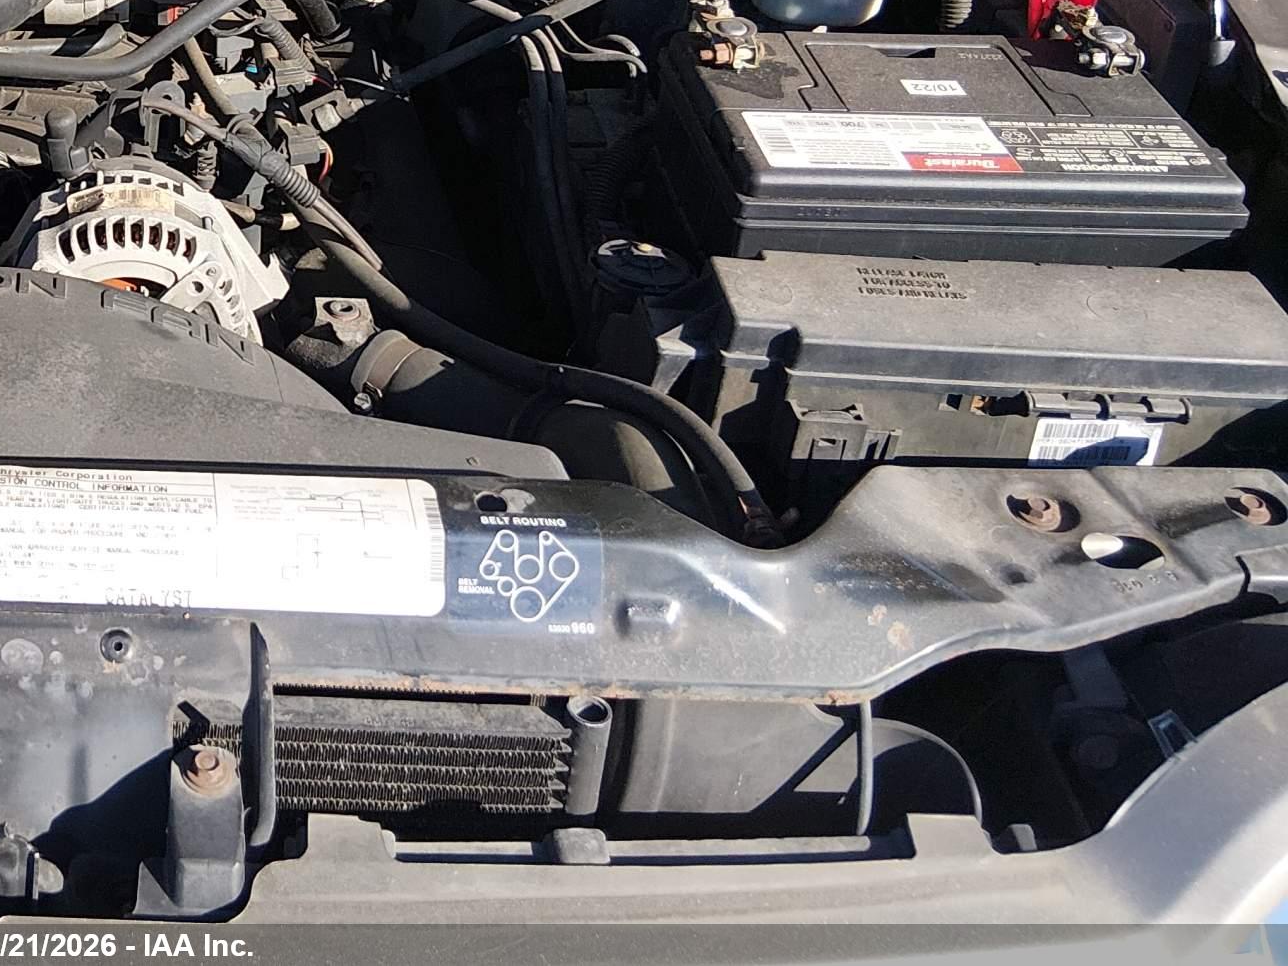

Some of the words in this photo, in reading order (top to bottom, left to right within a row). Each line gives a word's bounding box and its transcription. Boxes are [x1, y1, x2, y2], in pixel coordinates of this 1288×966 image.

[910, 82, 958, 93] 10/22
[923, 158, 1000, 170] Duralast
[99, 288, 255, 367] FAN
[55, 470, 133, 482] Corporation
[34, 478, 80, 489] CONTROL
[92, 484, 168, 493] INFORMATION
[479, 515, 510, 526] BELT
[511, 517, 567, 528] ROUTING
[457, 577, 479, 585] BELT
[457, 585, 496, 595] REMOVAL
[104, 587, 192, 610] CATALYST
[571, 621, 595, 635] 960
